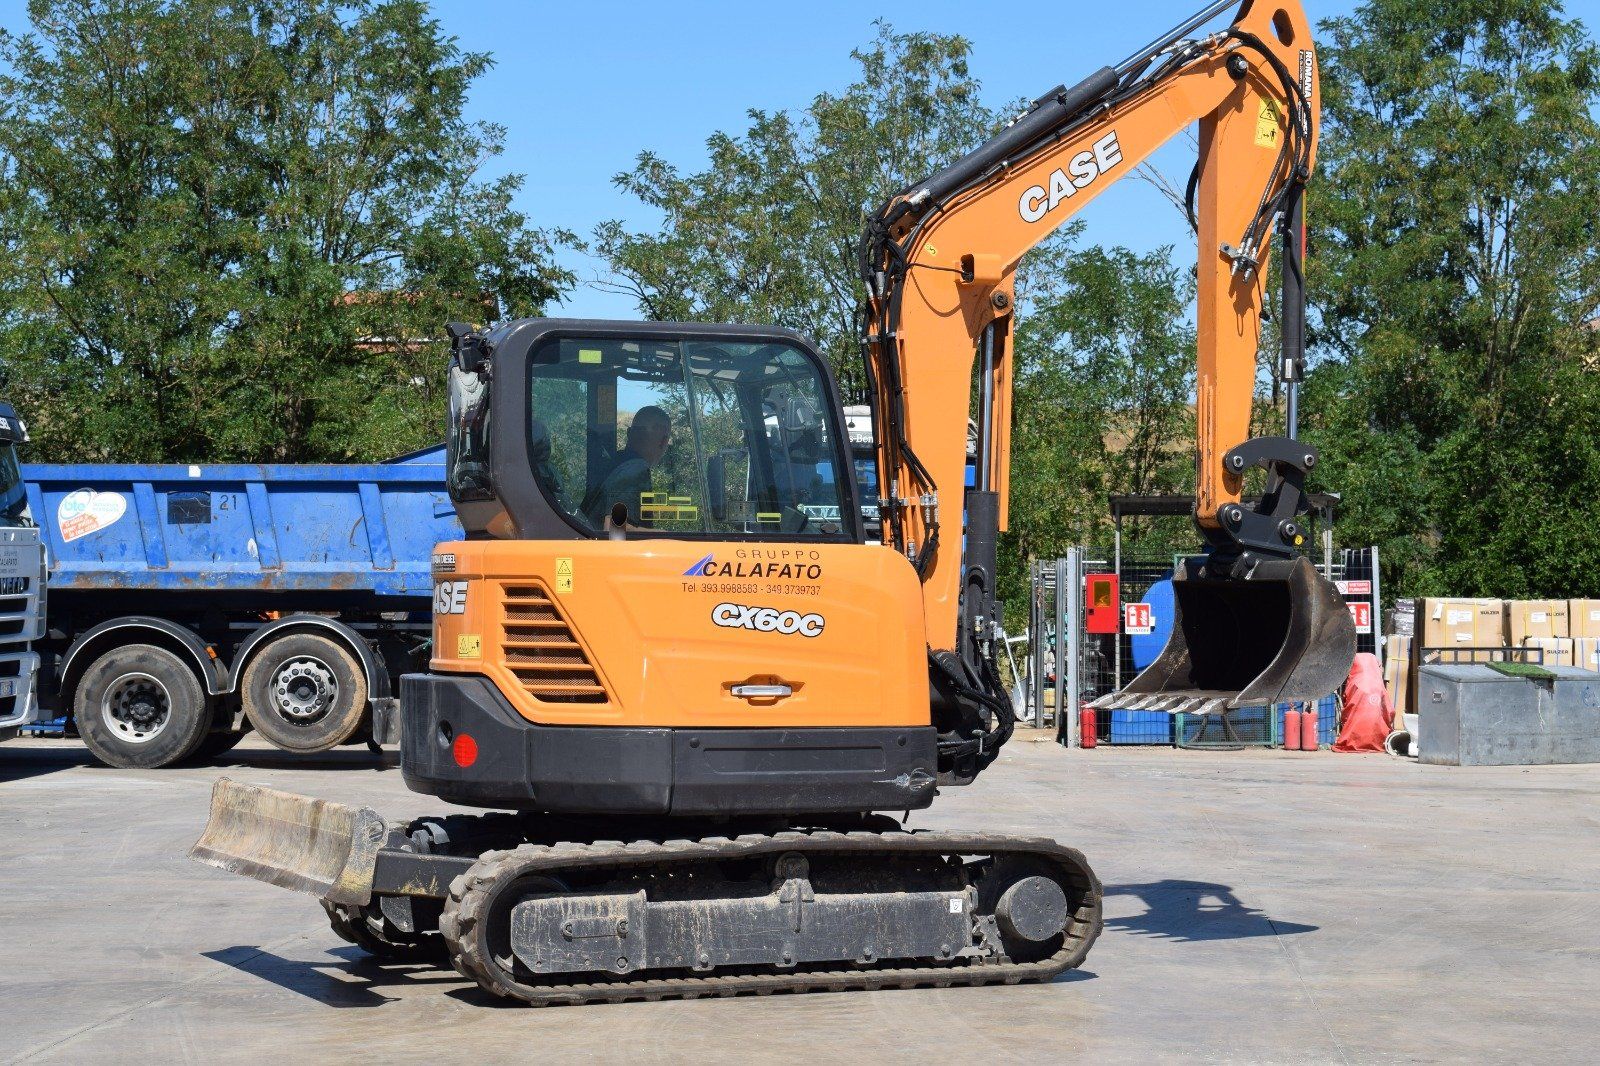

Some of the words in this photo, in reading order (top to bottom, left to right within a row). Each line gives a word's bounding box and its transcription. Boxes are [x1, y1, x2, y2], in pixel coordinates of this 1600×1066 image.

[1304, 50, 1313, 98] ROMANA
[1018, 129, 1124, 224] CASE
[219, 494, 237, 511] 21
[736, 549, 821, 561] GRUPPO
[703, 561, 822, 580] CALAFATO
[682, 582, 697, 593] Tel.
[711, 602, 826, 638] CX60C
